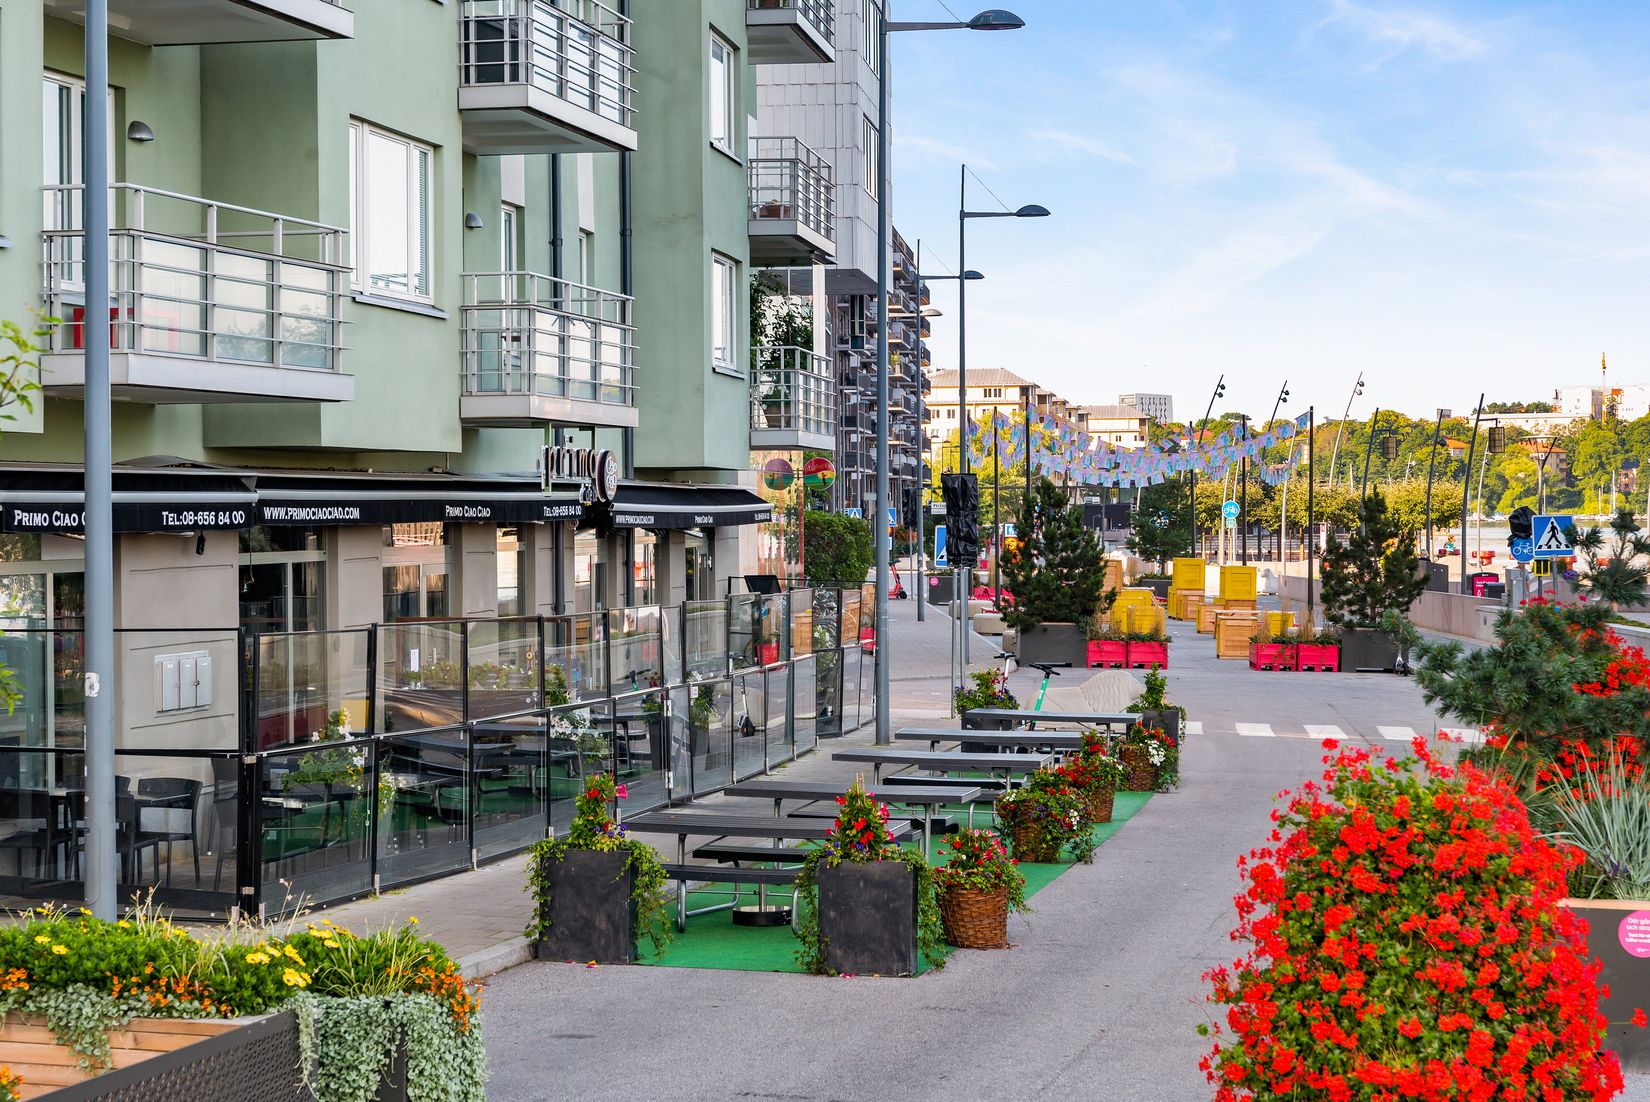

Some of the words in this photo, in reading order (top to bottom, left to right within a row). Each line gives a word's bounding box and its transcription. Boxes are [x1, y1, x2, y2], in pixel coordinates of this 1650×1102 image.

[14, 510, 49, 526] PRIMO
[52, 511, 79, 527] CIAO
[218, 511, 230, 525] 84
[232, 511, 246, 524] 00
[263, 506, 360, 520] WWW.PRIMOCIAOCIAO.COM
